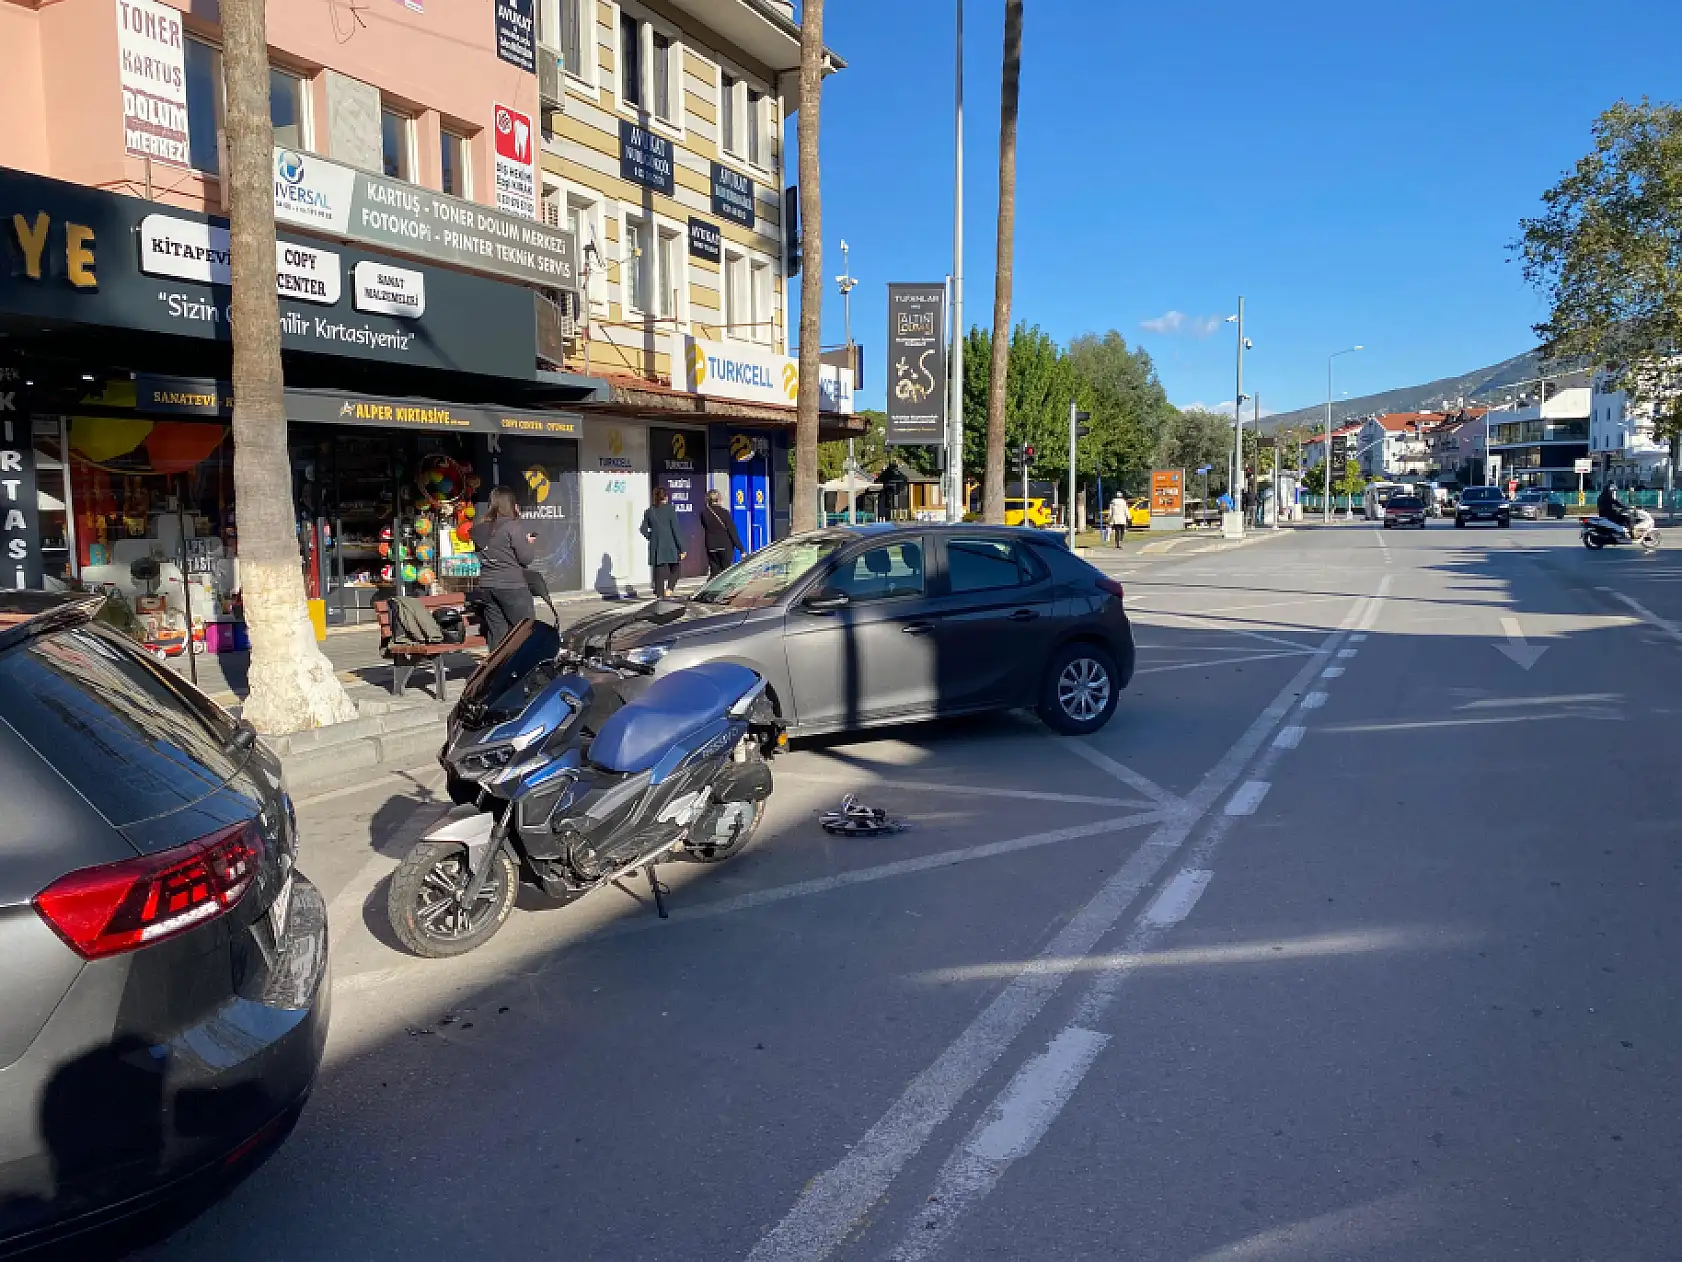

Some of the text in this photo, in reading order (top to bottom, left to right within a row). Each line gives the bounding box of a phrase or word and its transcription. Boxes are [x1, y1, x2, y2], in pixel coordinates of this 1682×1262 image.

[120, 1, 181, 48] TONER
[122, 47, 182, 92] KARTUŞ
[361, 207, 432, 242] FOTOKOPİ
[443, 229, 493, 258] PRINTER
[495, 242, 536, 269] TEKNİK
[366, 181, 421, 218] KARTUŞ
[432, 200, 474, 228] TONER
[477, 214, 520, 241] DOLUM
[522, 228, 566, 255] MERKEZİ
[13, 210, 98, 288] YE
[284, 247, 317, 271] COPY
[276, 273, 327, 297] CENTER
[708, 356, 774, 389] TURKCELL
[355, 402, 393, 421] ALPER
[395, 407, 451, 426] KIRTASİYE
[0, 391, 28, 590] KIRTASİ
